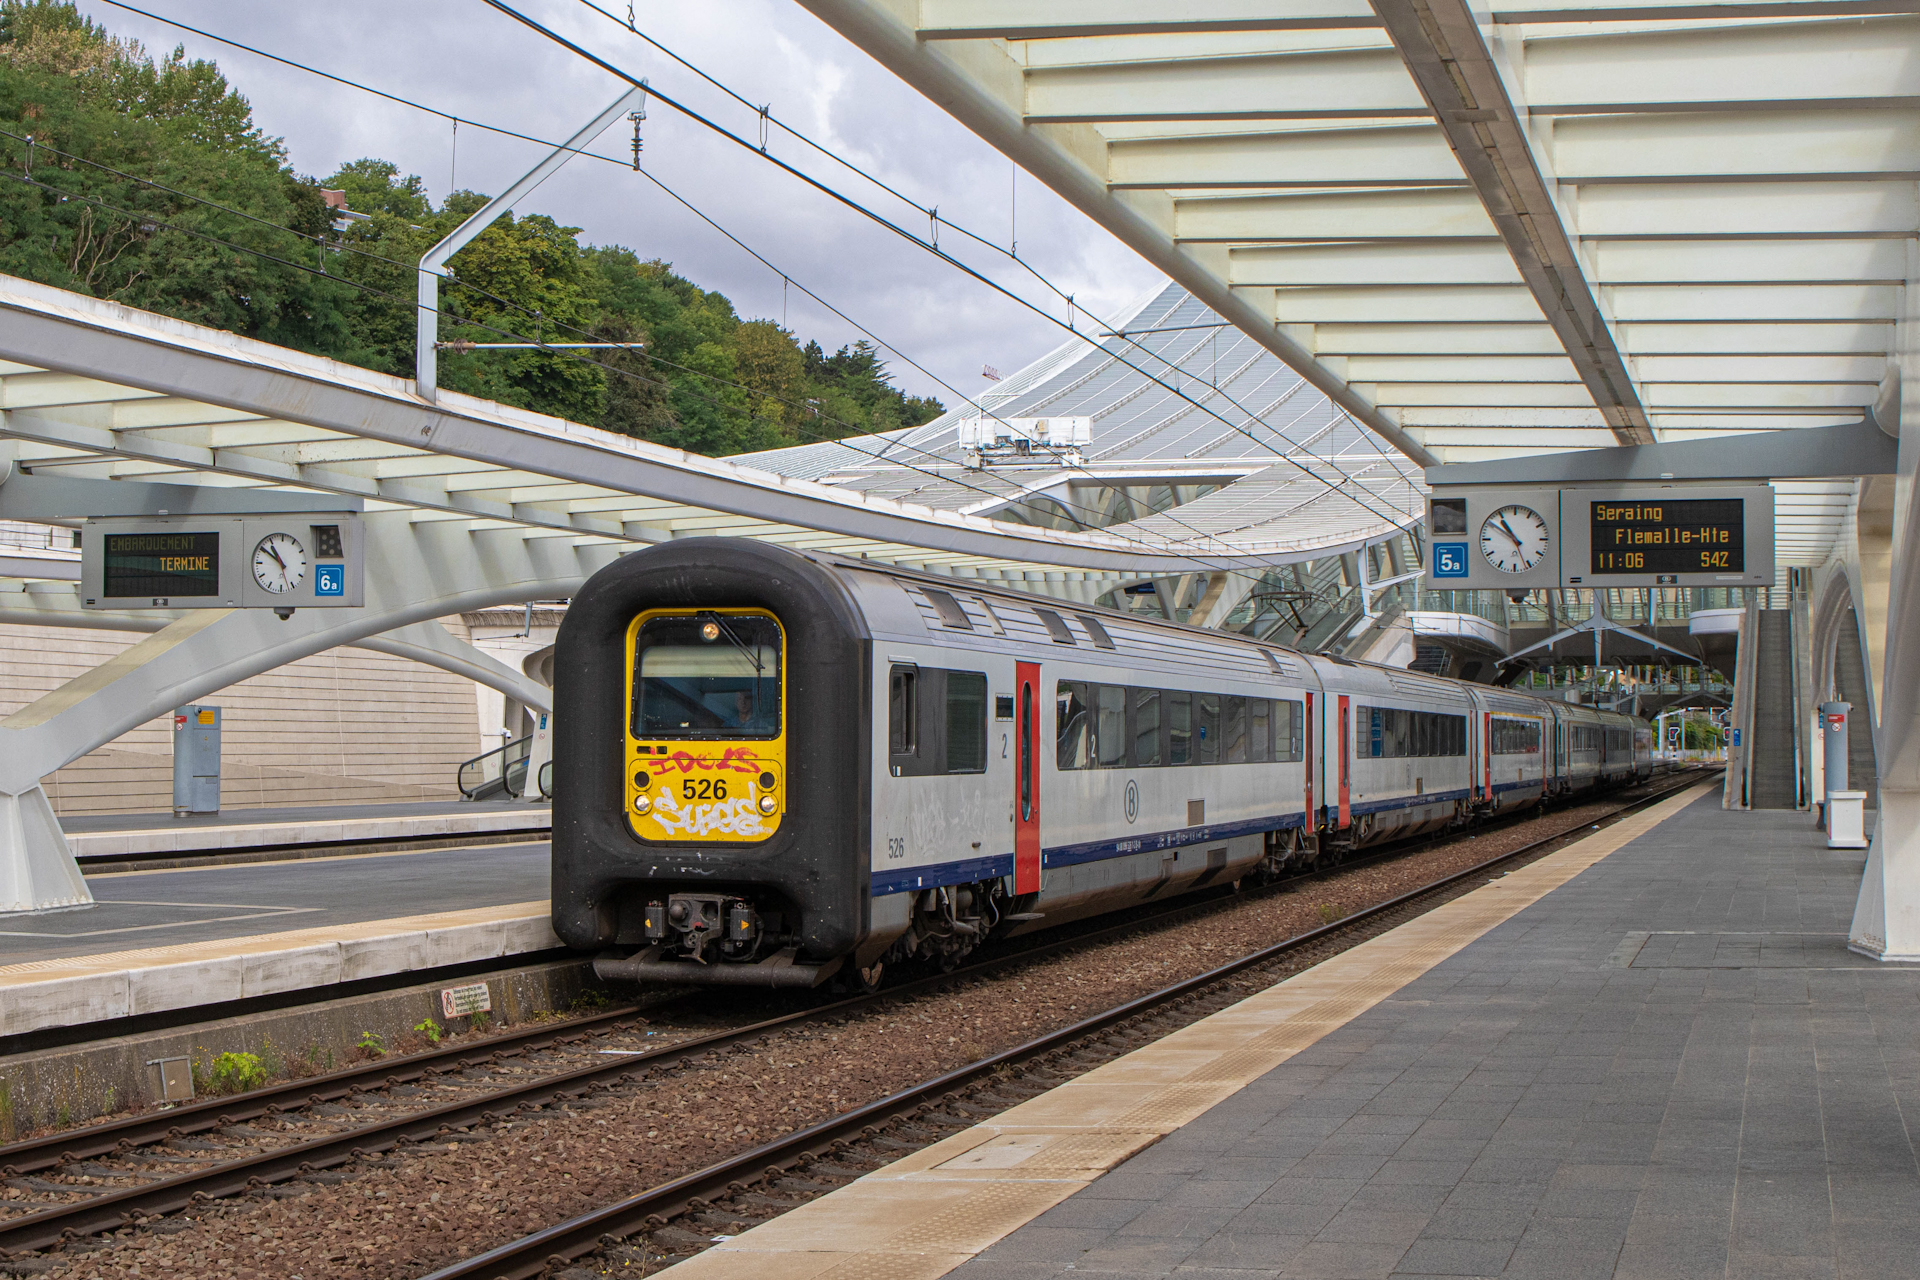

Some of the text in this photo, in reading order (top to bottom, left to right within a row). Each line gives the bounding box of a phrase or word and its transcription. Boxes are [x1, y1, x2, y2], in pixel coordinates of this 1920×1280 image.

[1597, 504, 1662, 522] Seraing
[110, 536, 195, 551] EMBARQUEMENT
[160, 556, 209, 571] TERMINE
[1441, 554, 1460, 571] 5a
[1599, 551, 1729, 569] 11:06 S42
[321, 575, 337, 590] 6a
[1002, 733, 1007, 759] 2
[1091, 734, 1097, 758] 2
[682, 778, 727, 800] 526
[888, 837, 904, 859] 526
